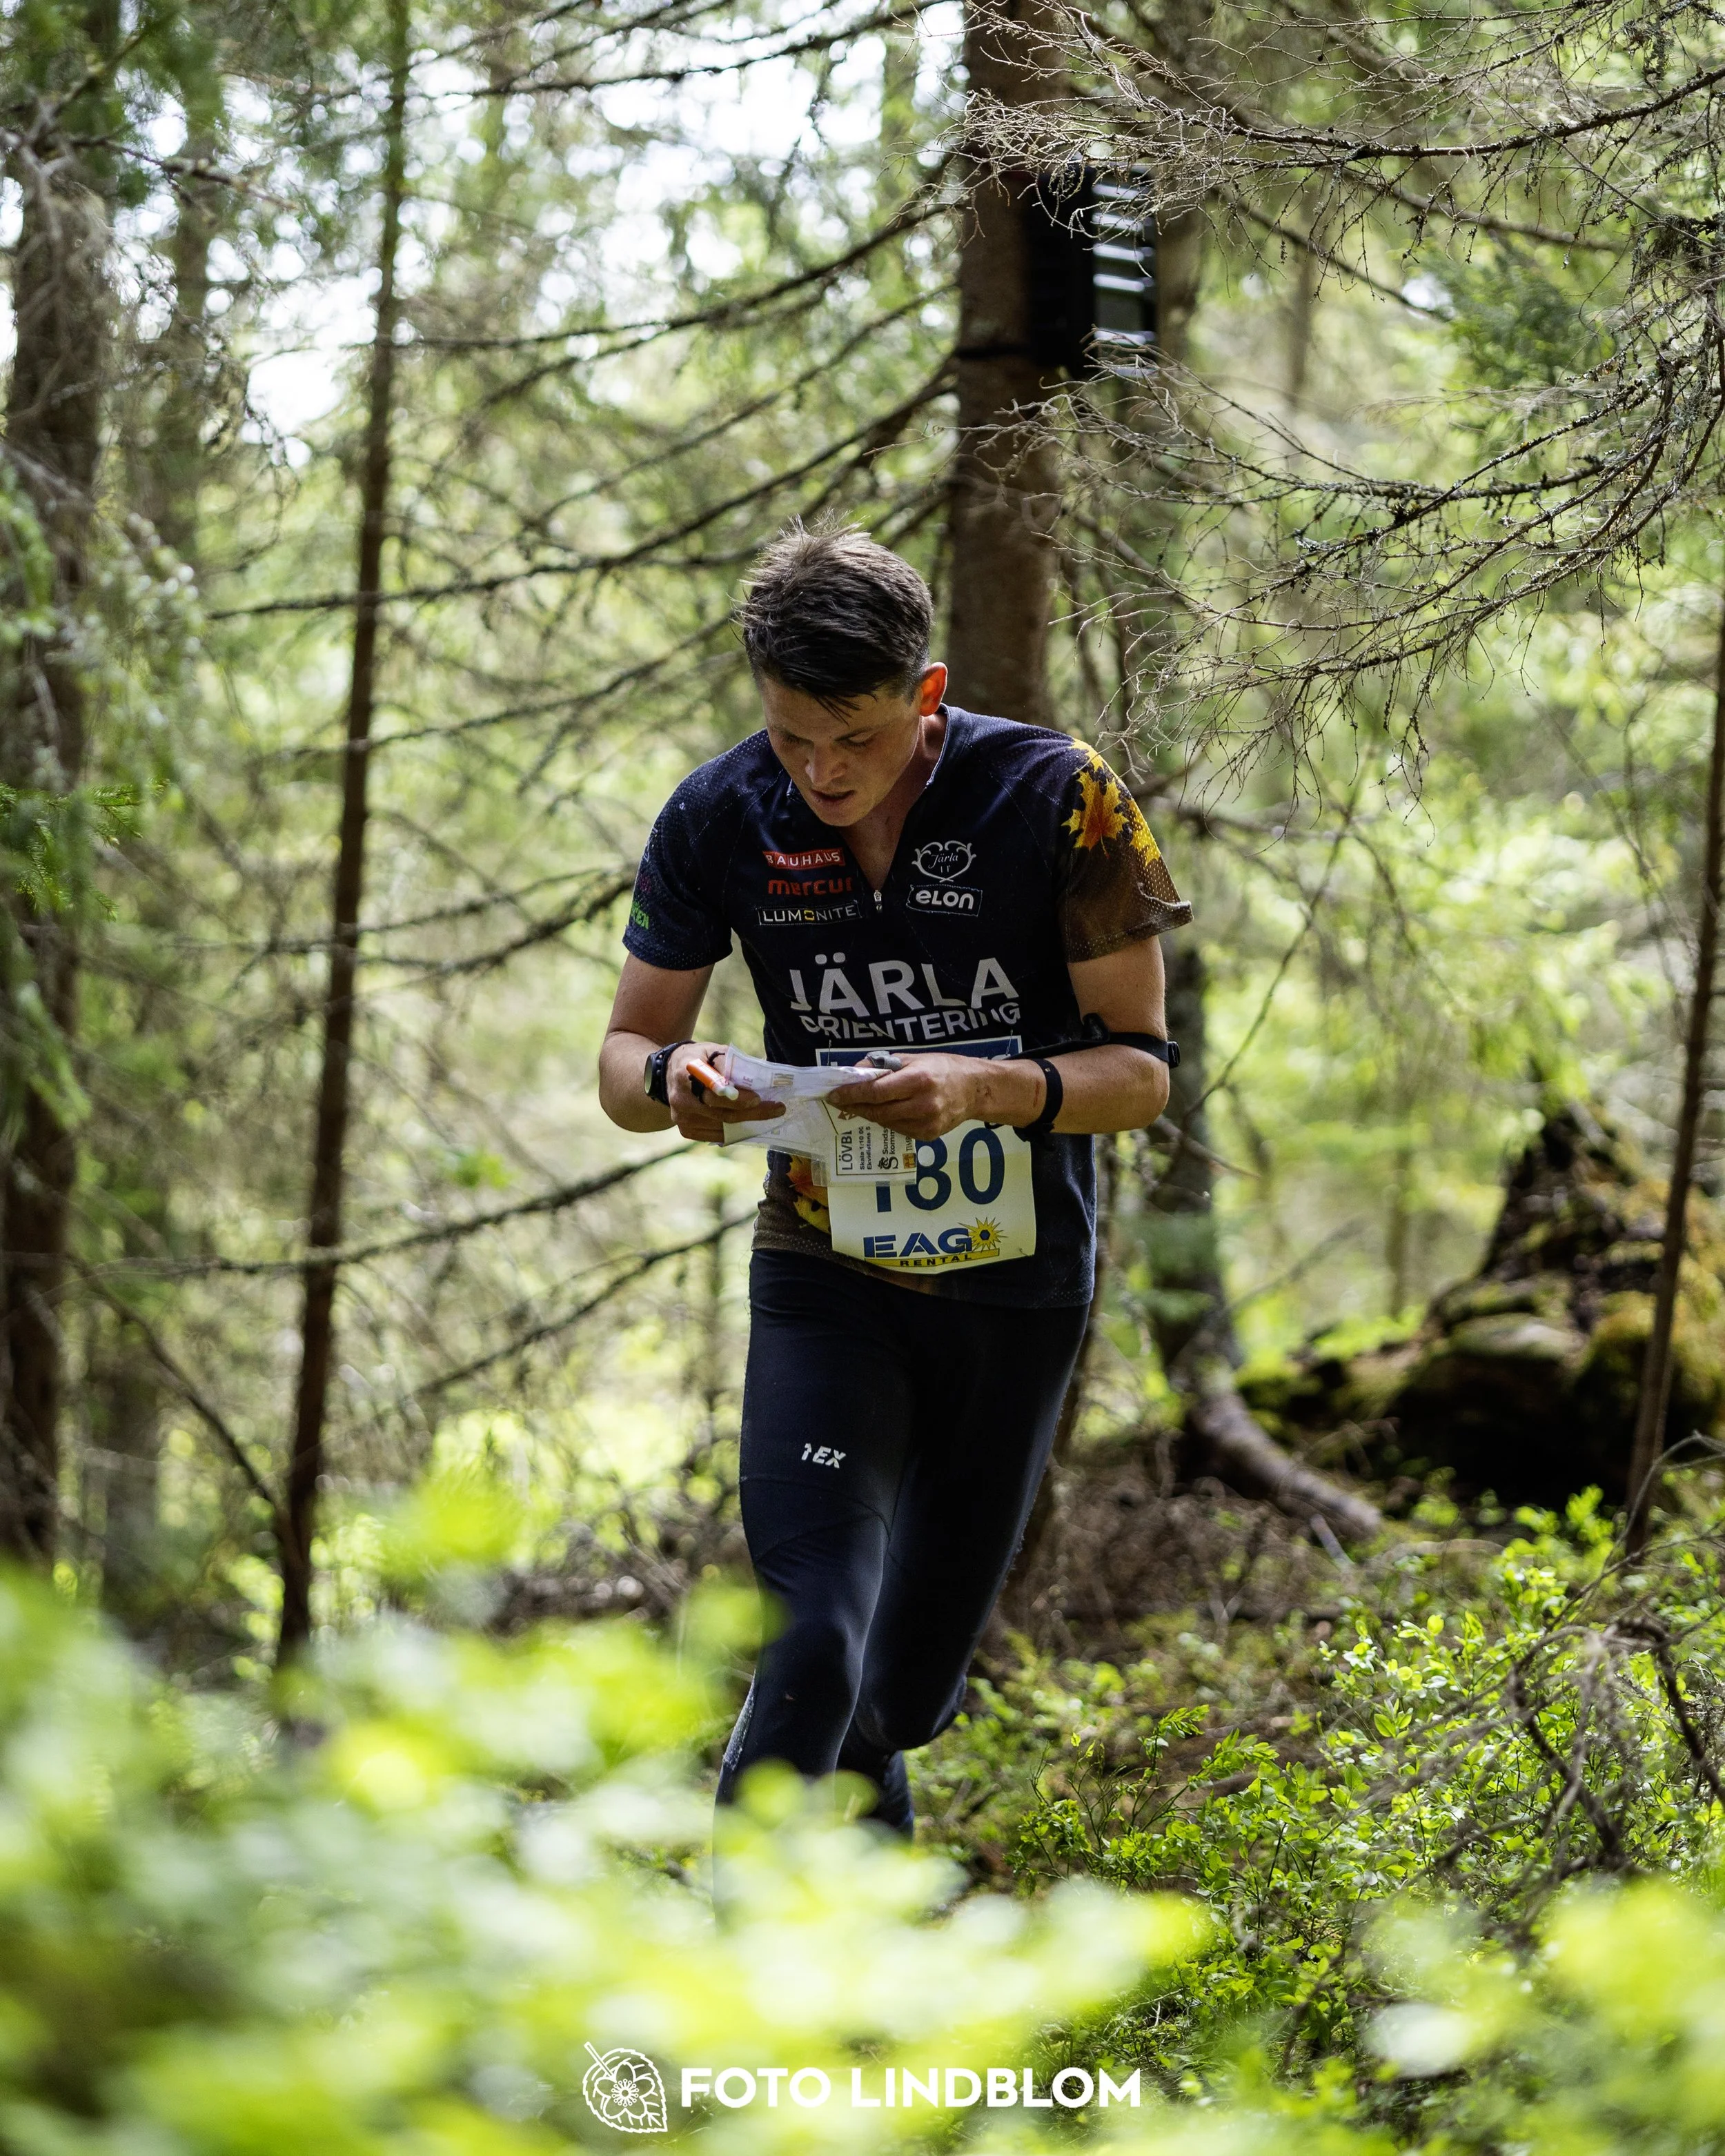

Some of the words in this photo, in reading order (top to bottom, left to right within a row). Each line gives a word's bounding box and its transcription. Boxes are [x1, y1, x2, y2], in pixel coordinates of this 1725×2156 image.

[765, 852, 840, 866] BAUHAUS
[928, 853, 958, 869] Järla
[768, 877, 853, 896] mercur
[763, 905, 856, 922] LUMONITE
[789, 952, 1019, 1018] JÄRLA
[900, 1254, 972, 1267] RENTAL
